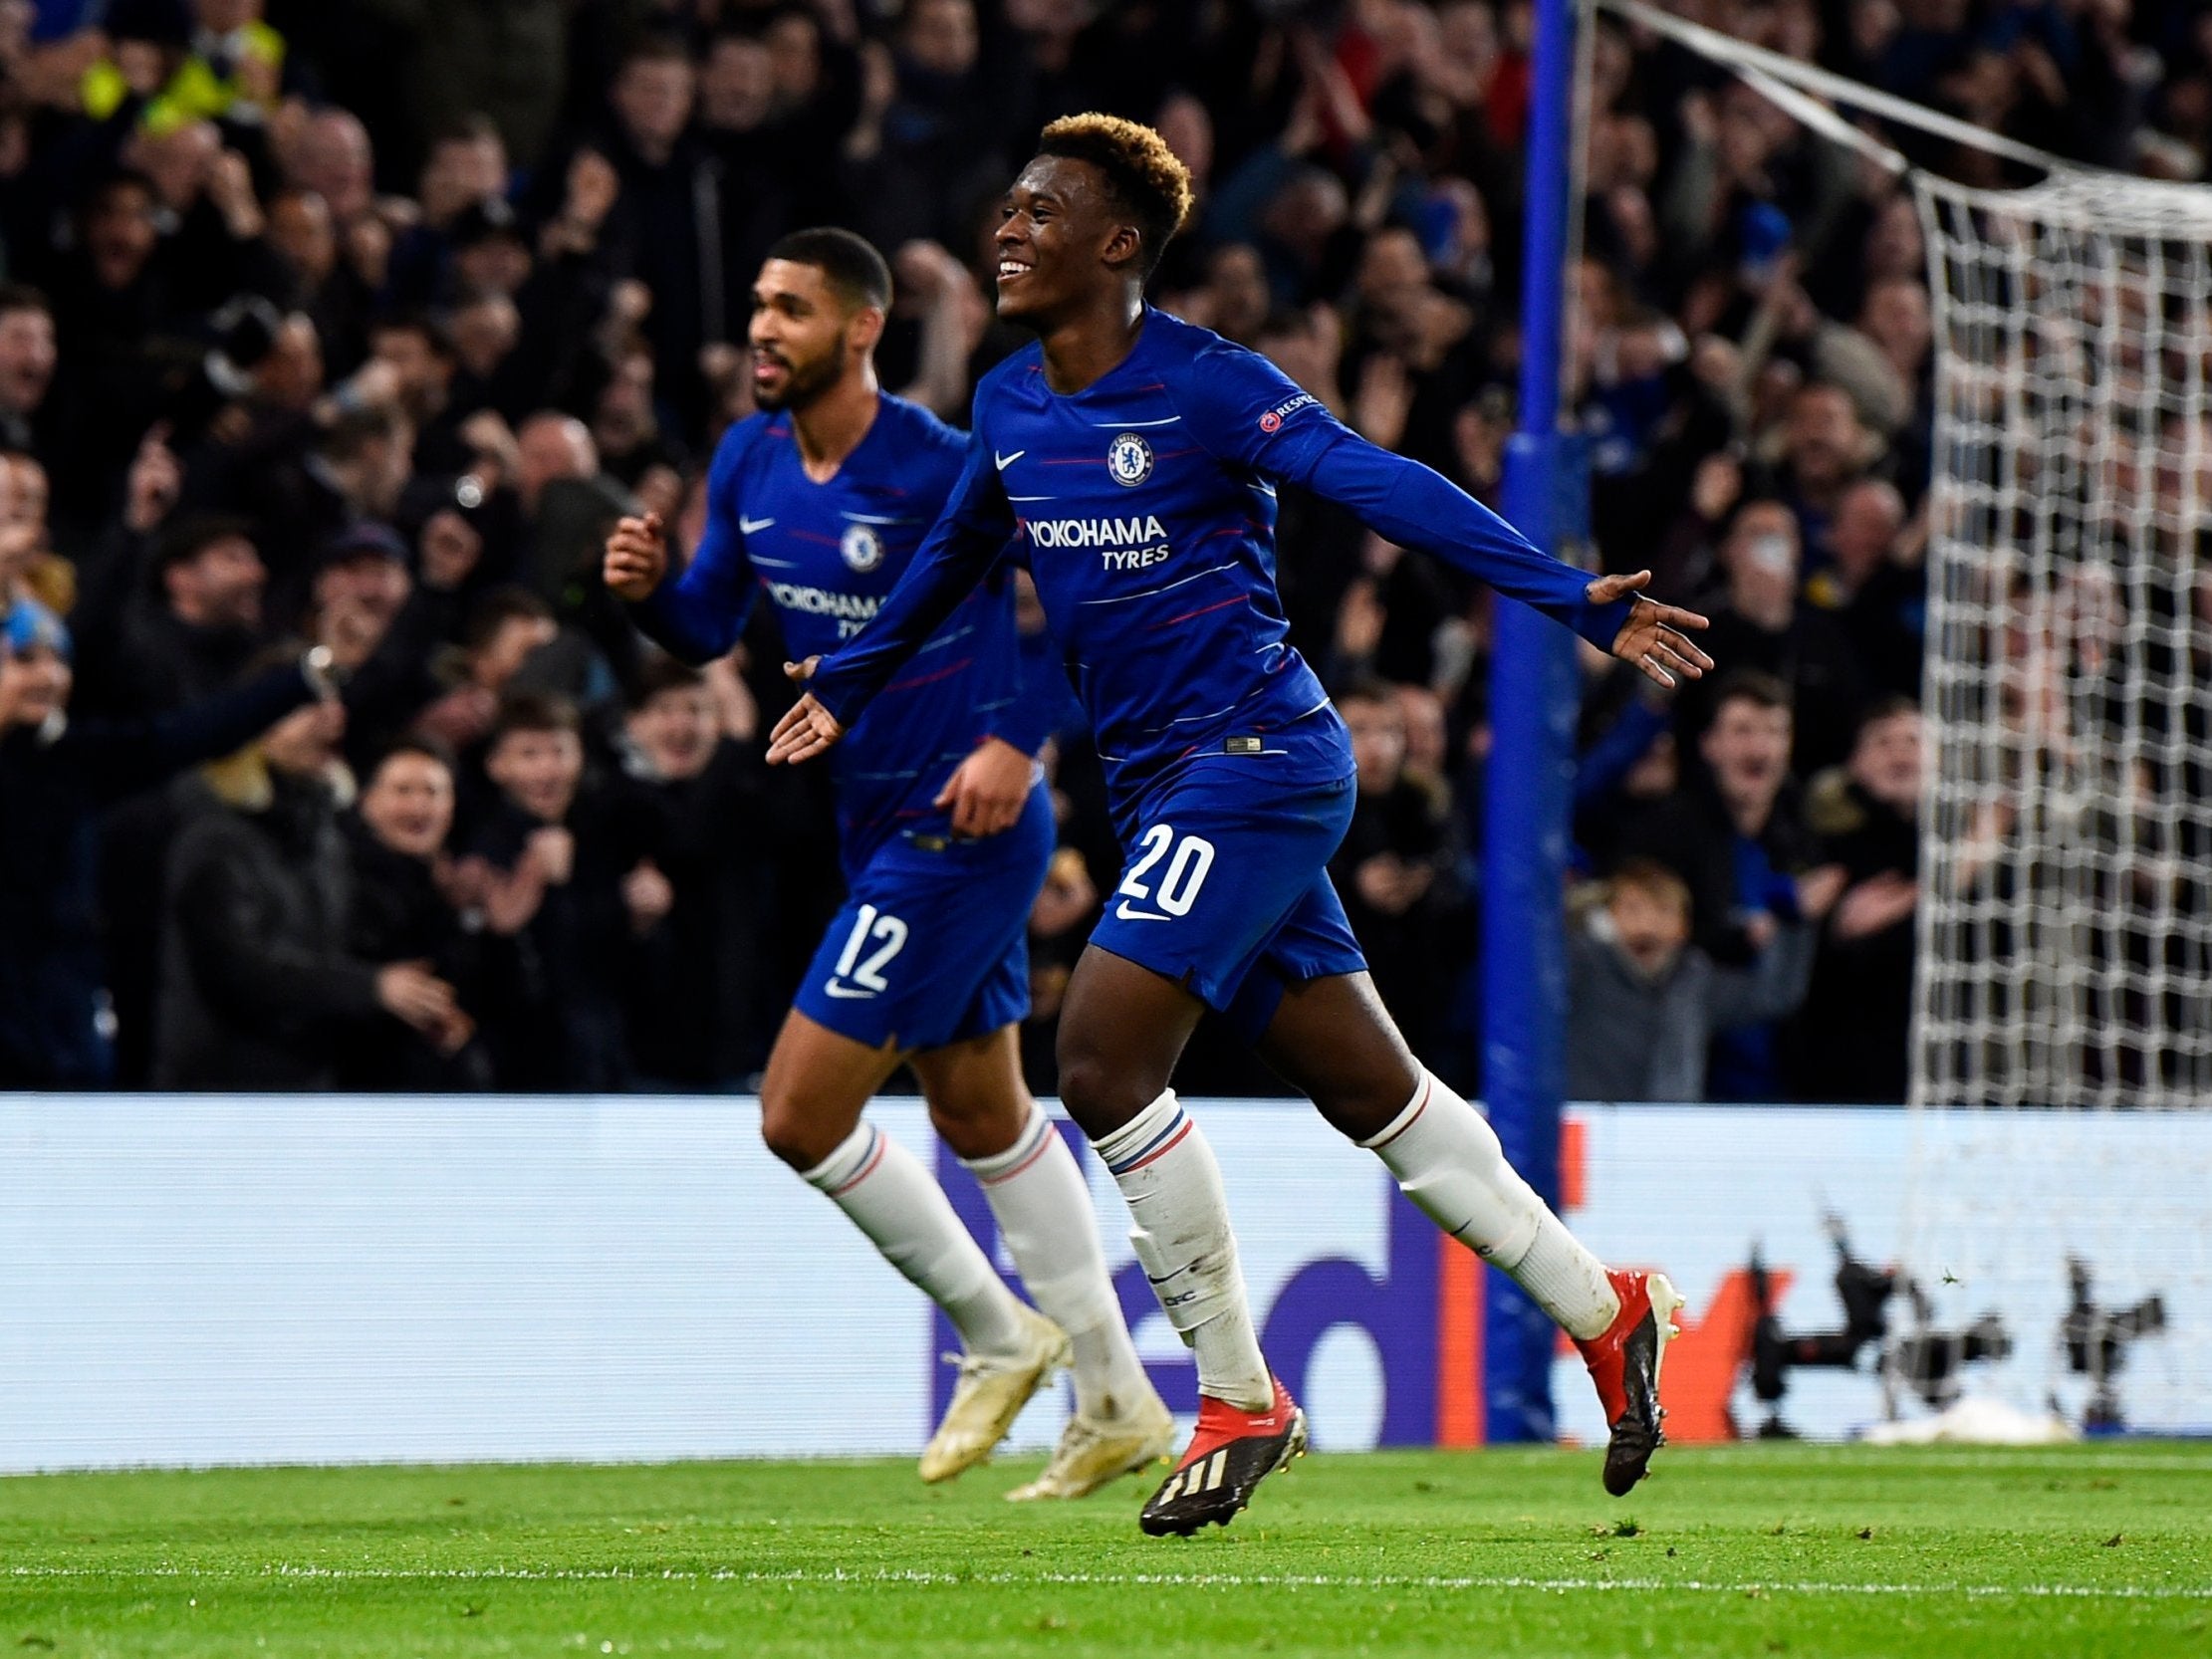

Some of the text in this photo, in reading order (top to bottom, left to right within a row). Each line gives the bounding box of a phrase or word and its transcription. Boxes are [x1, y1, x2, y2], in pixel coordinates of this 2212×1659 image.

[1025, 515, 1168, 548] YOKOHAMA
[1102, 544, 1169, 571] TYRES
[766, 582, 887, 620] YOKOHAM
[1118, 824, 1215, 917] 20
[835, 903, 908, 993] 12
